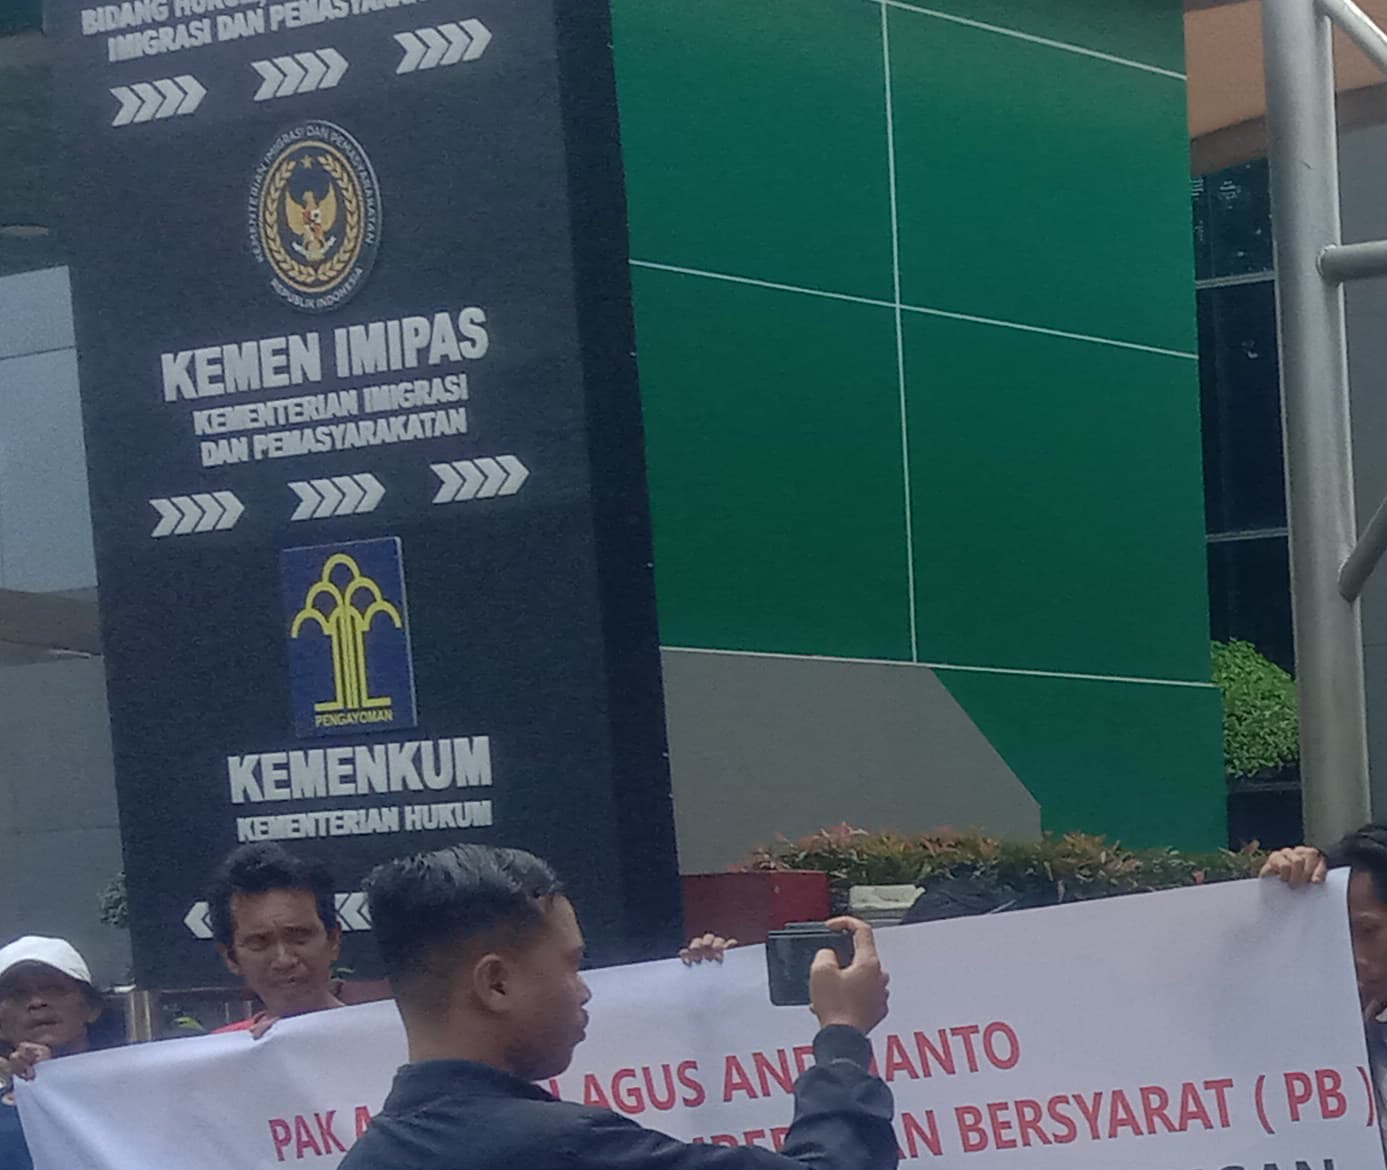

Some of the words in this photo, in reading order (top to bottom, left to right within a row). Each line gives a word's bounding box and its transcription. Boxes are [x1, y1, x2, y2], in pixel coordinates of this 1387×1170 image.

[108, 18, 213, 62] IMIGRASI
[217, 9, 265, 41] DAN
[161, 332, 321, 403] KEMEN
[335, 307, 489, 379] IMIPAS
[193, 391, 358, 436] KEMENTERIAN
[365, 374, 469, 415] IMIGRASI
[201, 436, 248, 467] DAN
[254, 408, 467, 459] PEMASYARAKATAN
[315, 709, 394, 728] PENGAYOMAN
[228, 736, 493, 804] KEMENKUM
[237, 805, 400, 844] KEMENTERIAN
[405, 800, 493, 833] HUKUM
[583, 1060, 706, 1114] AGUS
[268, 1110, 347, 1162] PAK
[961, 1078, 1234, 1153] BERSYARAT
